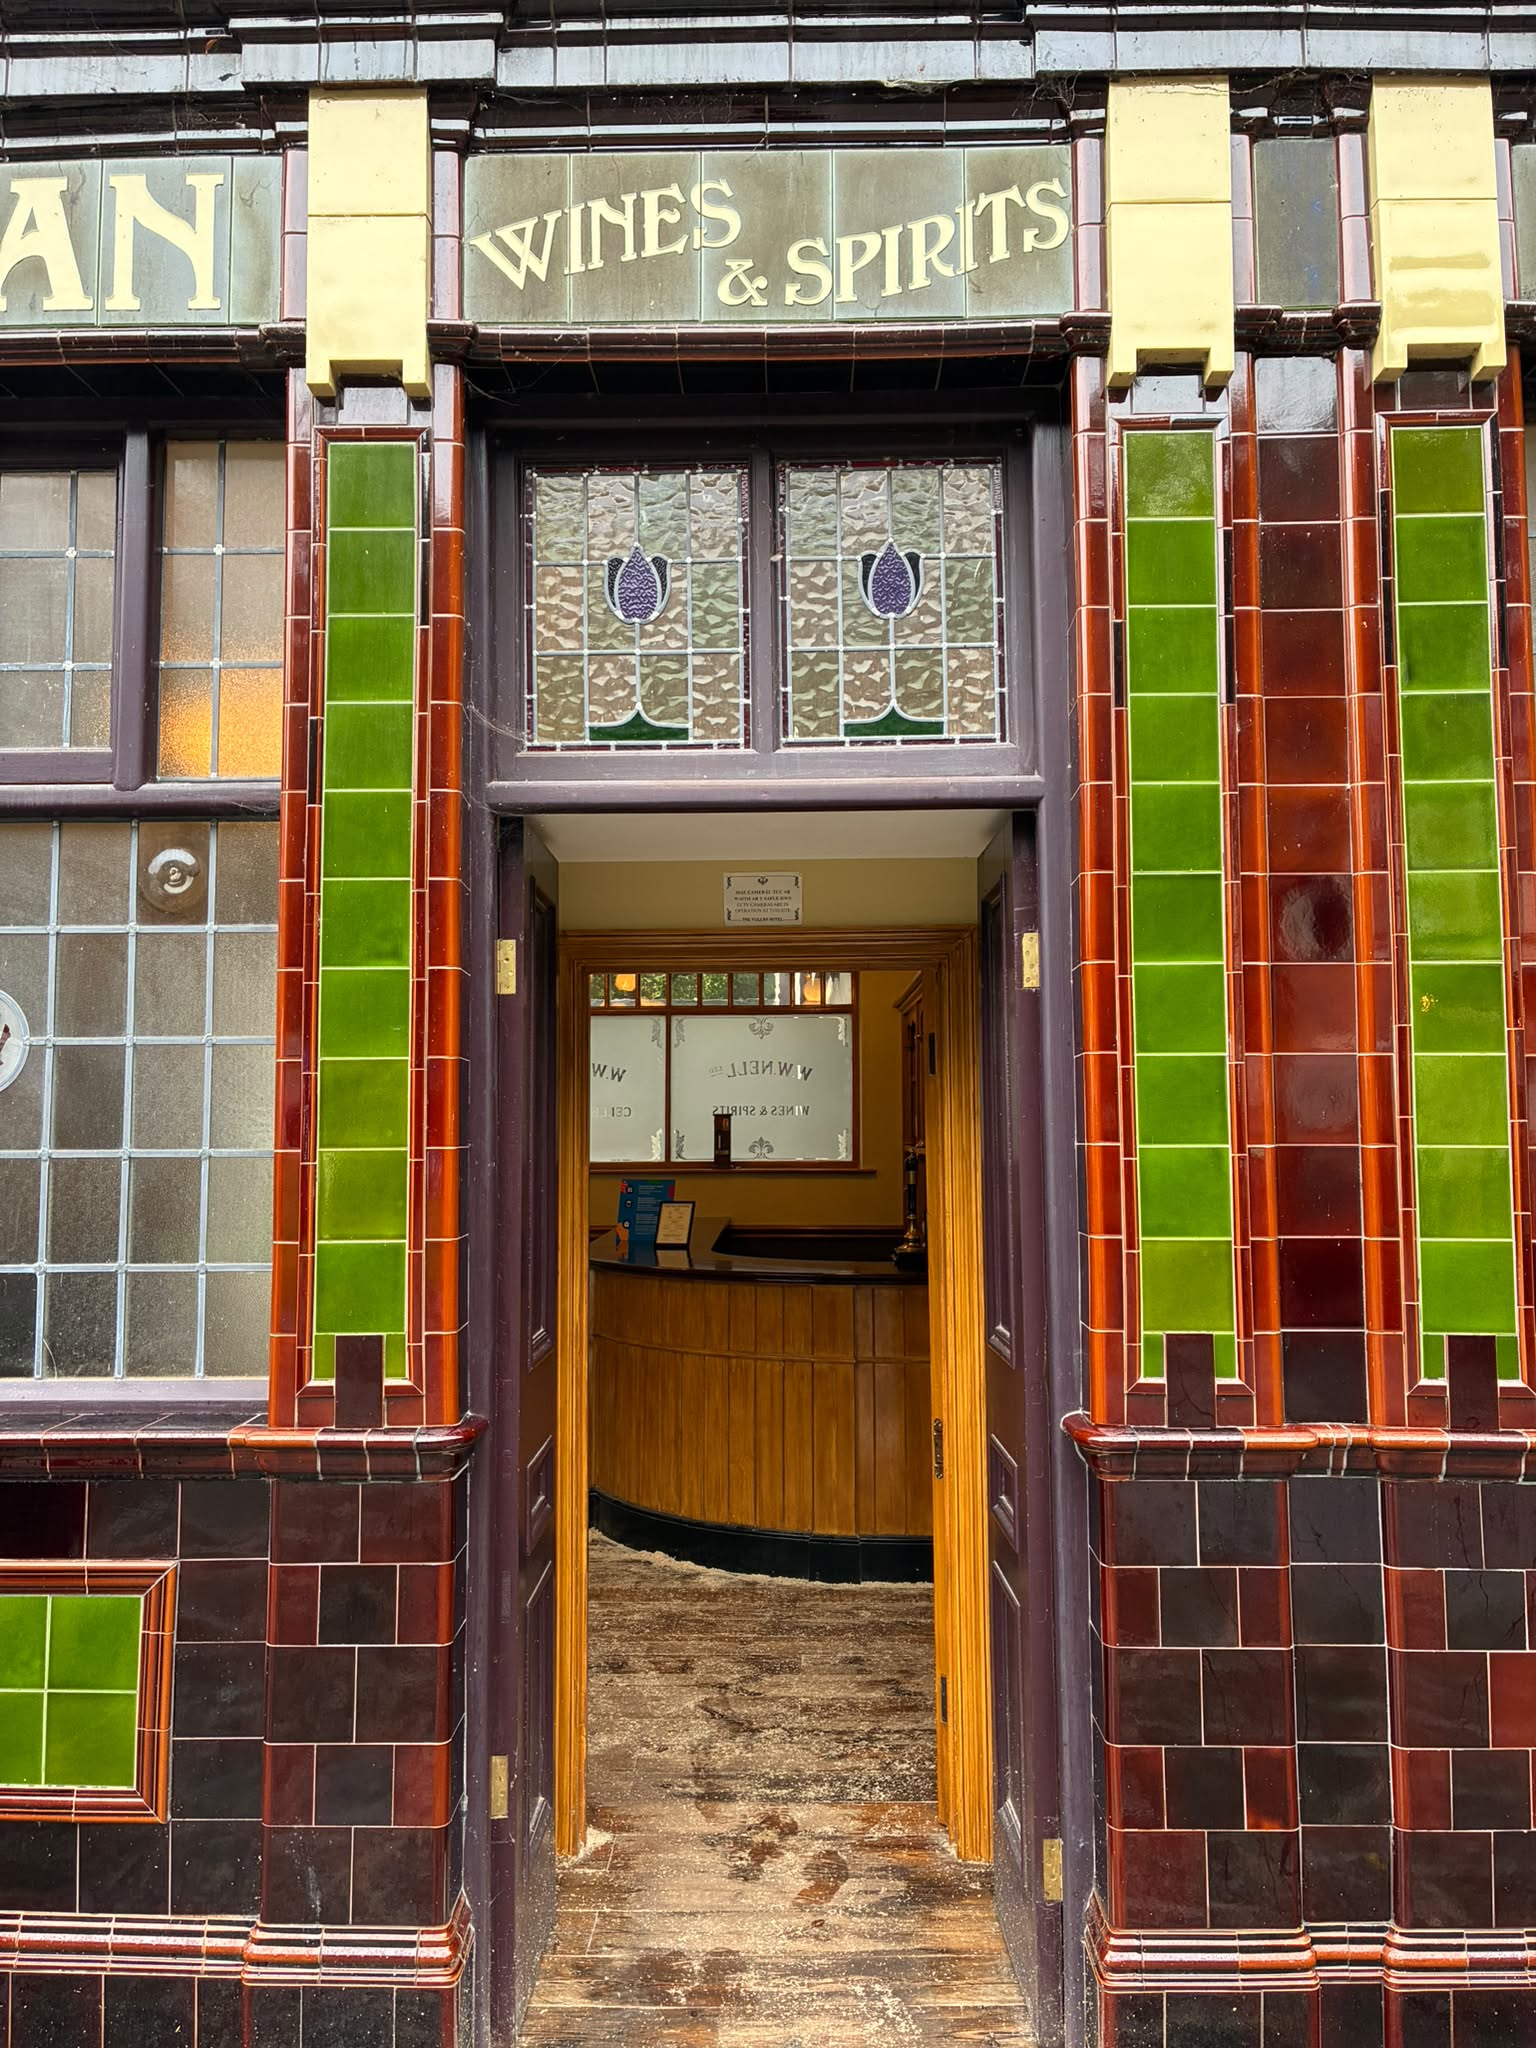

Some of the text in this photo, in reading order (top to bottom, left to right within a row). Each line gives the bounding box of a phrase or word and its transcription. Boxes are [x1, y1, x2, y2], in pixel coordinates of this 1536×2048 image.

[469, 178, 742, 292] WINES
[716, 177, 1073, 307] & SPIRITS
